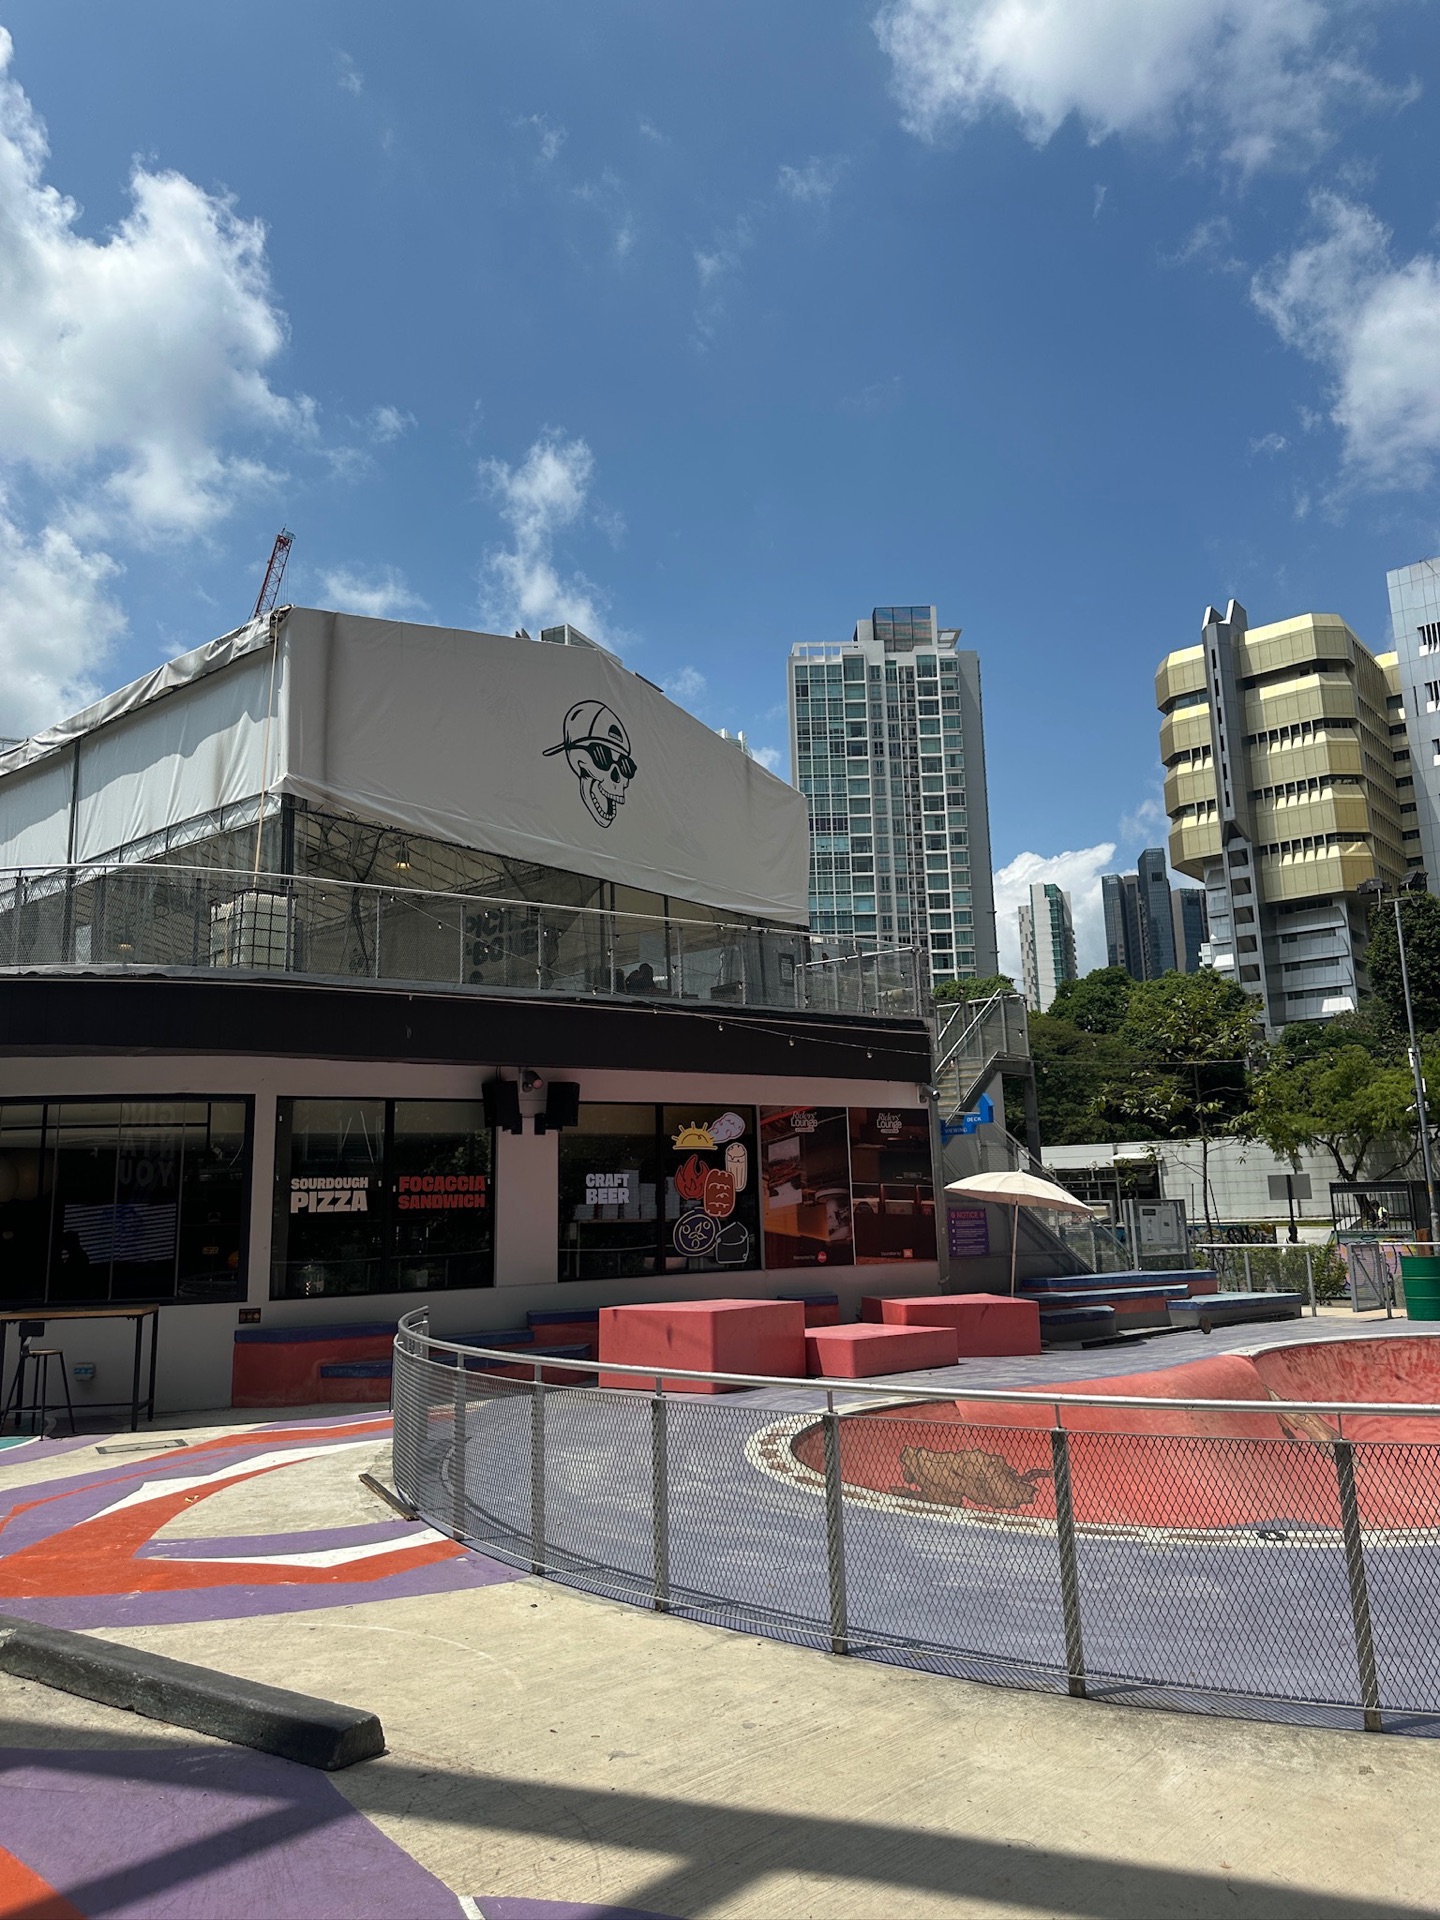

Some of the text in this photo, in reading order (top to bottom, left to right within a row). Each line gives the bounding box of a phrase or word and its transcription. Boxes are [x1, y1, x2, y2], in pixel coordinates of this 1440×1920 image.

[790, 1117, 818, 1129] Lounge
[876, 1119, 902, 1131] Lounge
[290, 1176, 369, 1190] SOURDOUGH
[398, 1175, 487, 1193] FOCACCIA
[585, 1173, 630, 1188] CRAFT
[290, 1189, 368, 1214] PIZZA
[398, 1193, 487, 1210] SANDWICH
[585, 1187, 631, 1205] BEER
[956, 1211, 979, 1219] NOTICE
